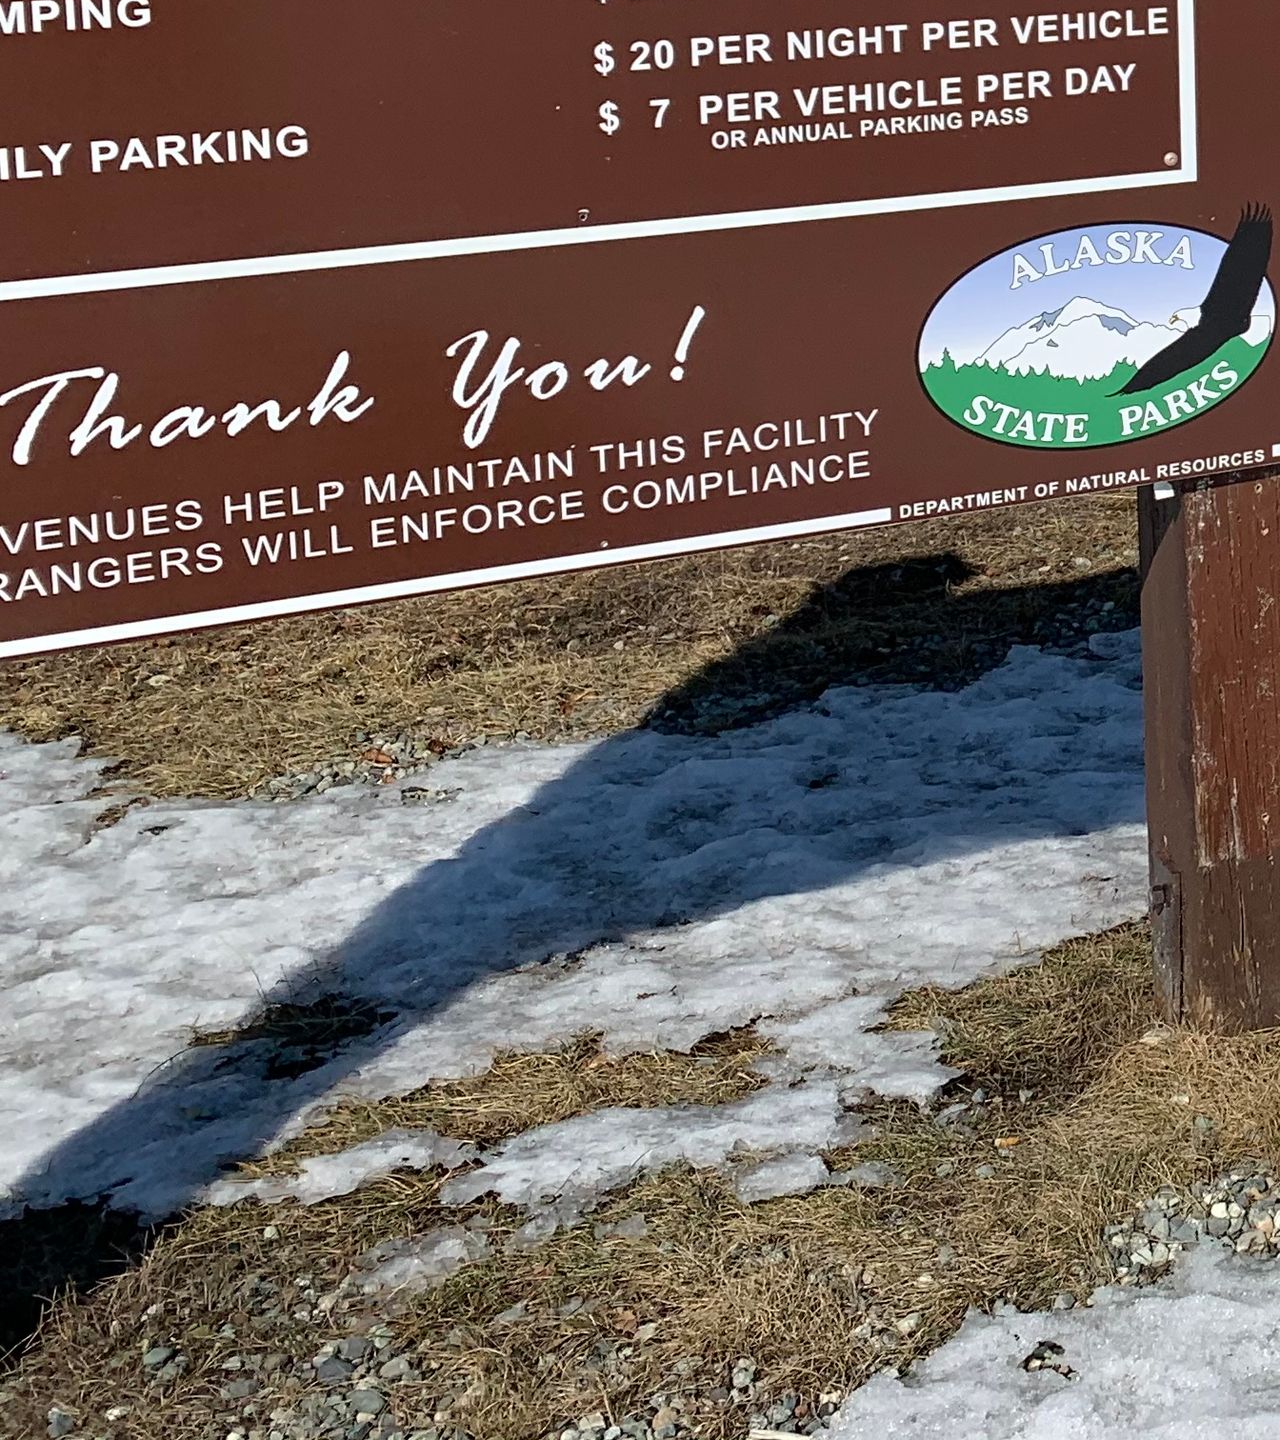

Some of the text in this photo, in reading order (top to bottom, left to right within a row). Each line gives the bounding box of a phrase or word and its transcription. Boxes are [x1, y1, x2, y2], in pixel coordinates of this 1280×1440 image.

[593, 7, 1169, 77] $ 20 PER NIGHT PER VEHICLE
[598, 63, 1137, 136] $ 7 PER VEHICLE PER DAY
[711, 106, 1029, 150] OR ANNUAL PARKING PASS
[90, 125, 309, 173] PARKING
[1010, 231, 1195, 290] ALASKA
[0, 305, 706, 466] Thank You!
[963, 361, 1239, 443] STATE PARKS
[0, 408, 879, 554] VENUES HELP MAINTAIN THIS FACILITY
[241, 525, 354, 566] WILL
[370, 490, 585, 548] ENFORCE
[602, 450, 871, 514] COMPLIANCE
[899, 449, 1265, 519] DEPARTMENT OF NATURAL RESOURCES
